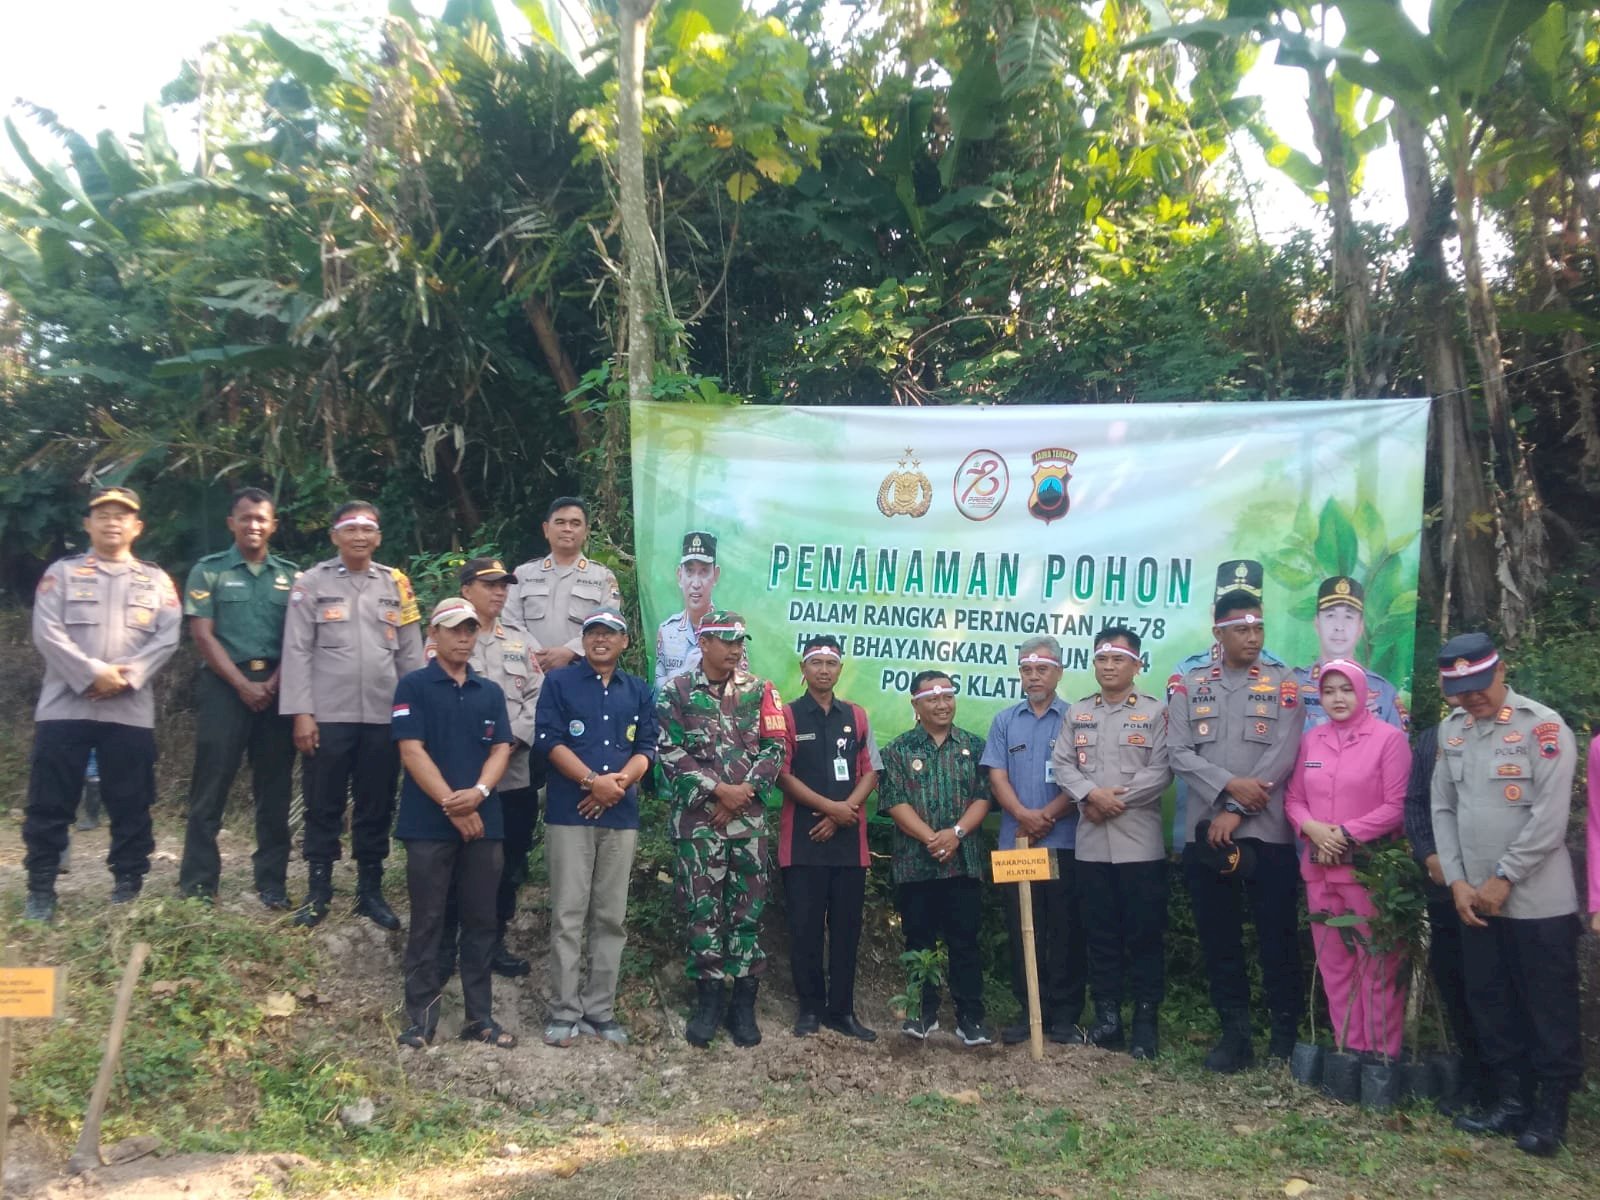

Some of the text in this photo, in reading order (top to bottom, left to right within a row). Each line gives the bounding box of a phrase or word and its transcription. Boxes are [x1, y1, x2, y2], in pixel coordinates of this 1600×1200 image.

[770, 544, 1191, 604] PENANAMAN POHON
[789, 601, 1166, 640] DALAM RANGKA PERINGATAN KE-78
[797, 633, 847, 655] HI
[852, 635, 1007, 665] BHAYANGKARA
[882, 670, 1028, 699] POS KLAT
[1248, 694, 1277, 704] POLRI
[995, 858, 1046, 866] WAKAPOLRES
[1006, 868, 1036, 876] KLATEN
